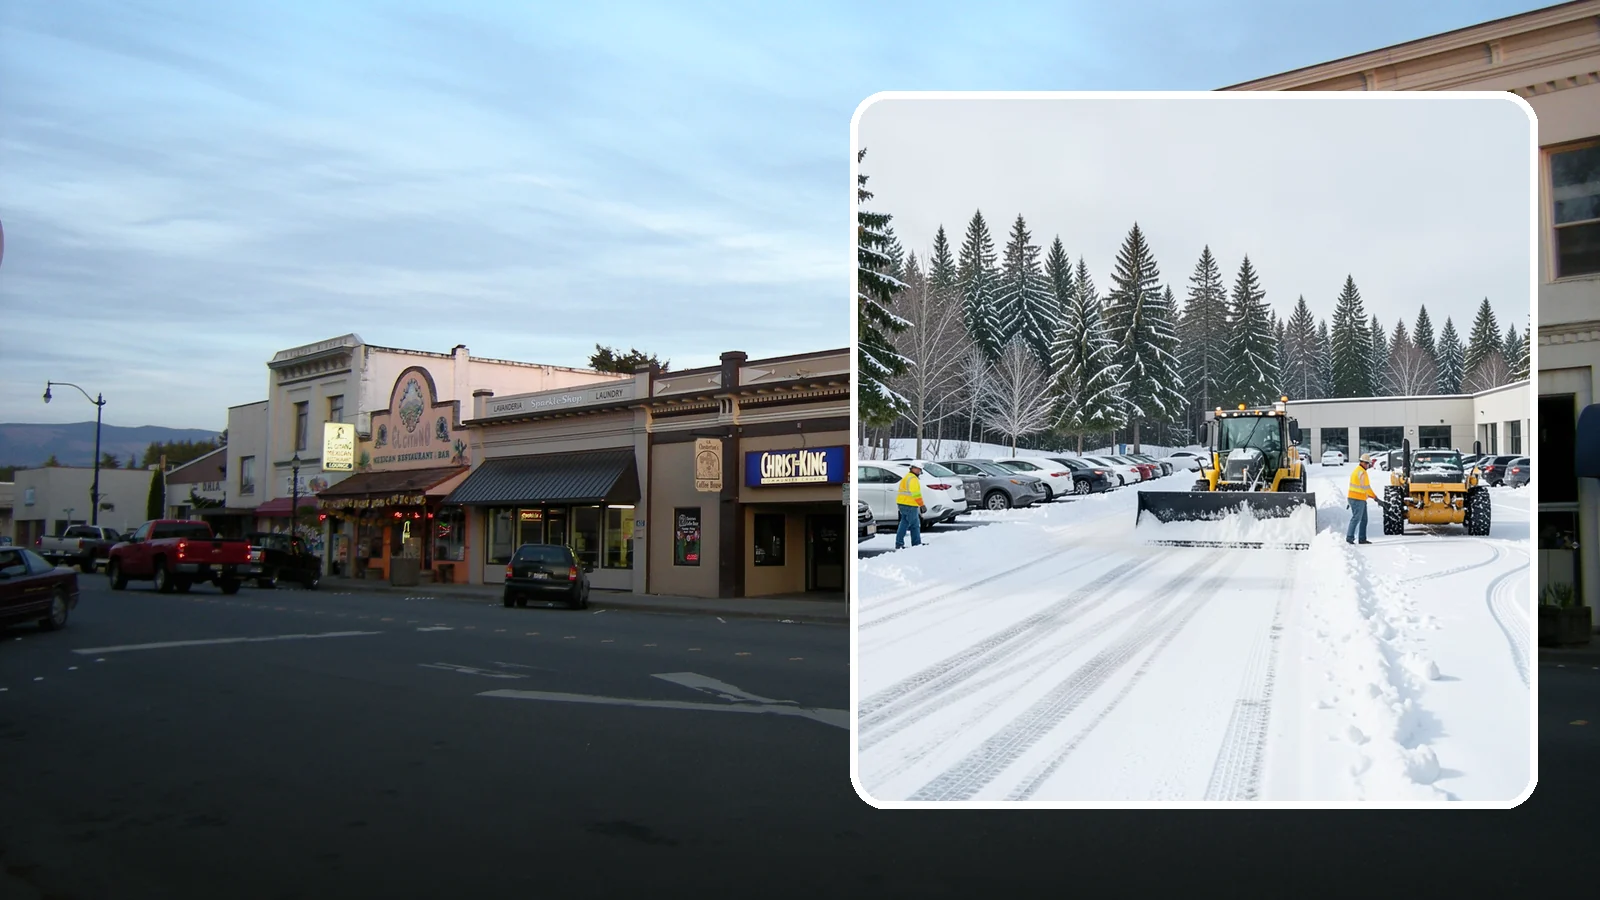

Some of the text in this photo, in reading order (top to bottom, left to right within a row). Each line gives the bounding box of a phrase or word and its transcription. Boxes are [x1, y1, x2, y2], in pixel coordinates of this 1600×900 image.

[493, 402, 523, 413] LAVANDERIA
[560, 394, 583, 405] Shop
[595, 389, 623, 400] LAUNDRY
[397, 451, 433, 462] RESTAURANT
[437, 450, 450, 459] BAR
[761, 450, 827, 477] CHRIST KING
